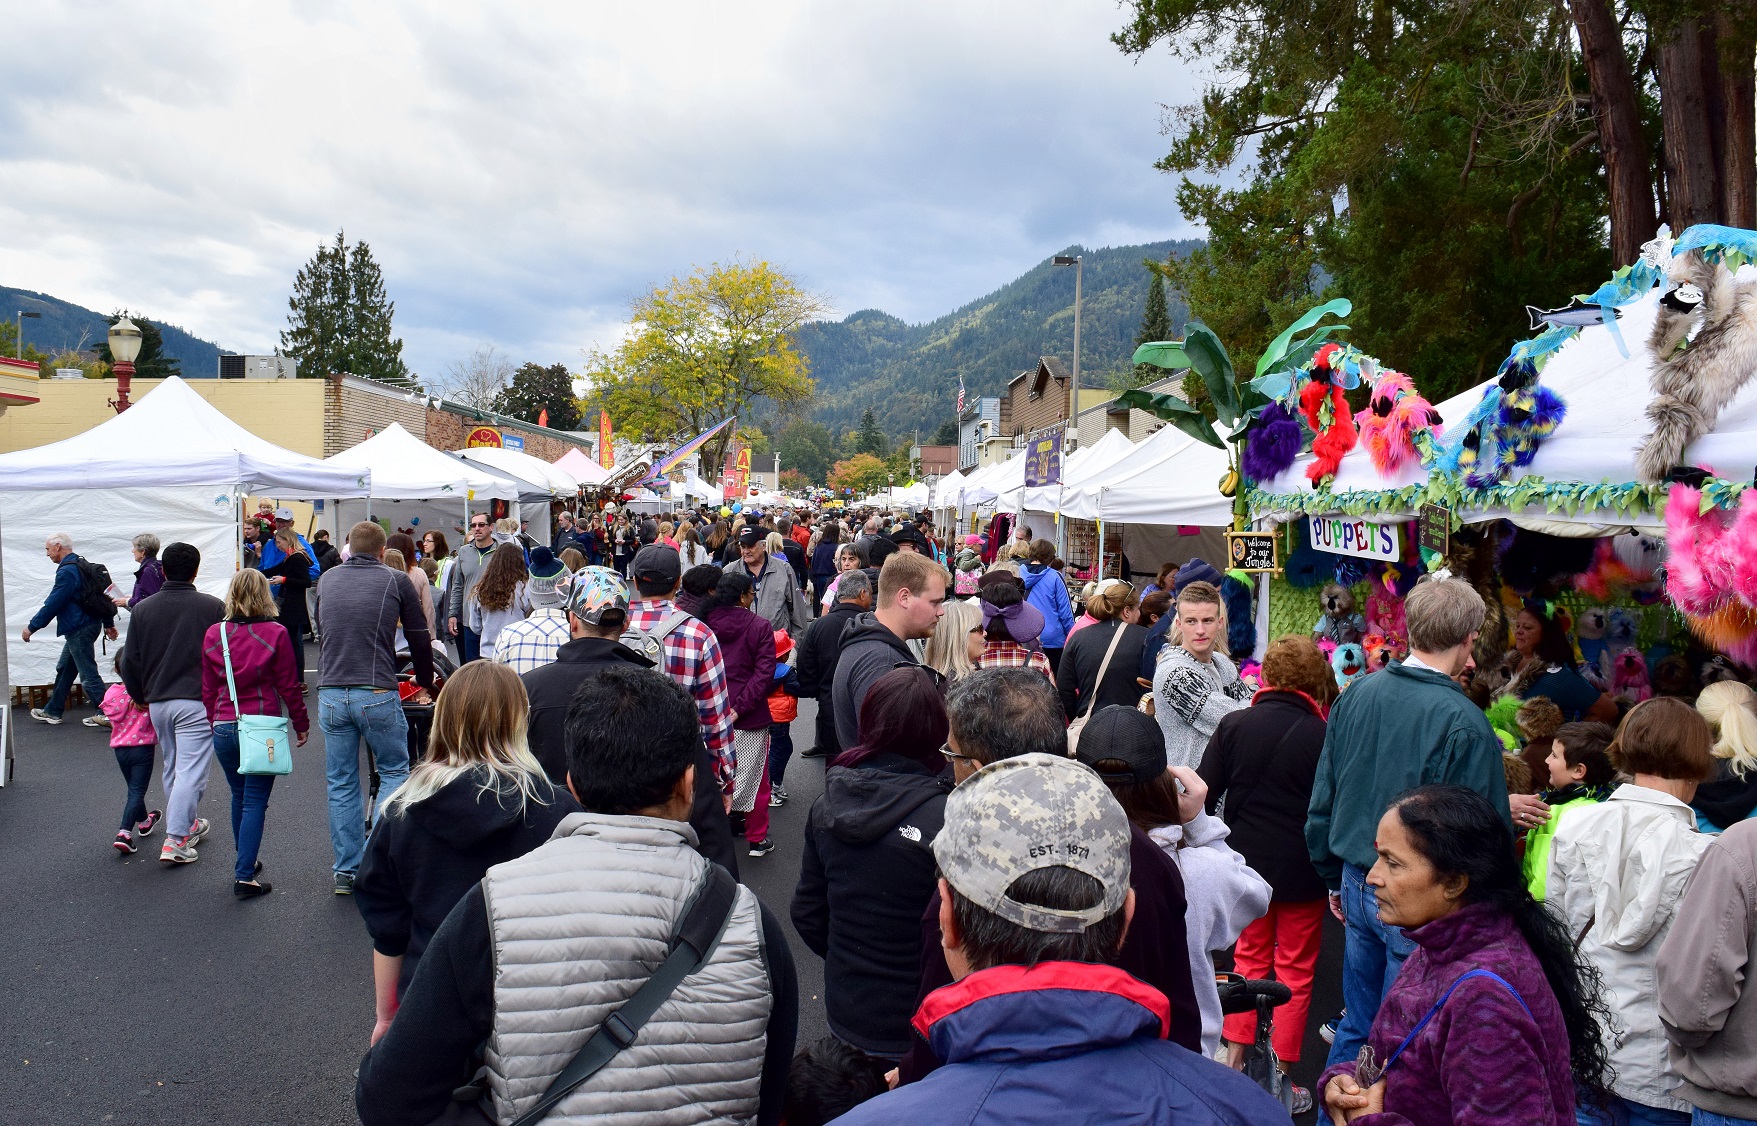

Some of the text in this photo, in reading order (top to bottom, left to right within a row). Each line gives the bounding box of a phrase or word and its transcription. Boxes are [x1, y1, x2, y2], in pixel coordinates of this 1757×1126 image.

[1313, 517, 1393, 554] PUPPETS
[1247, 537, 1271, 548] Welcome
[1250, 548, 1257, 557] to
[1029, 843, 1089, 859] EST. 1871
